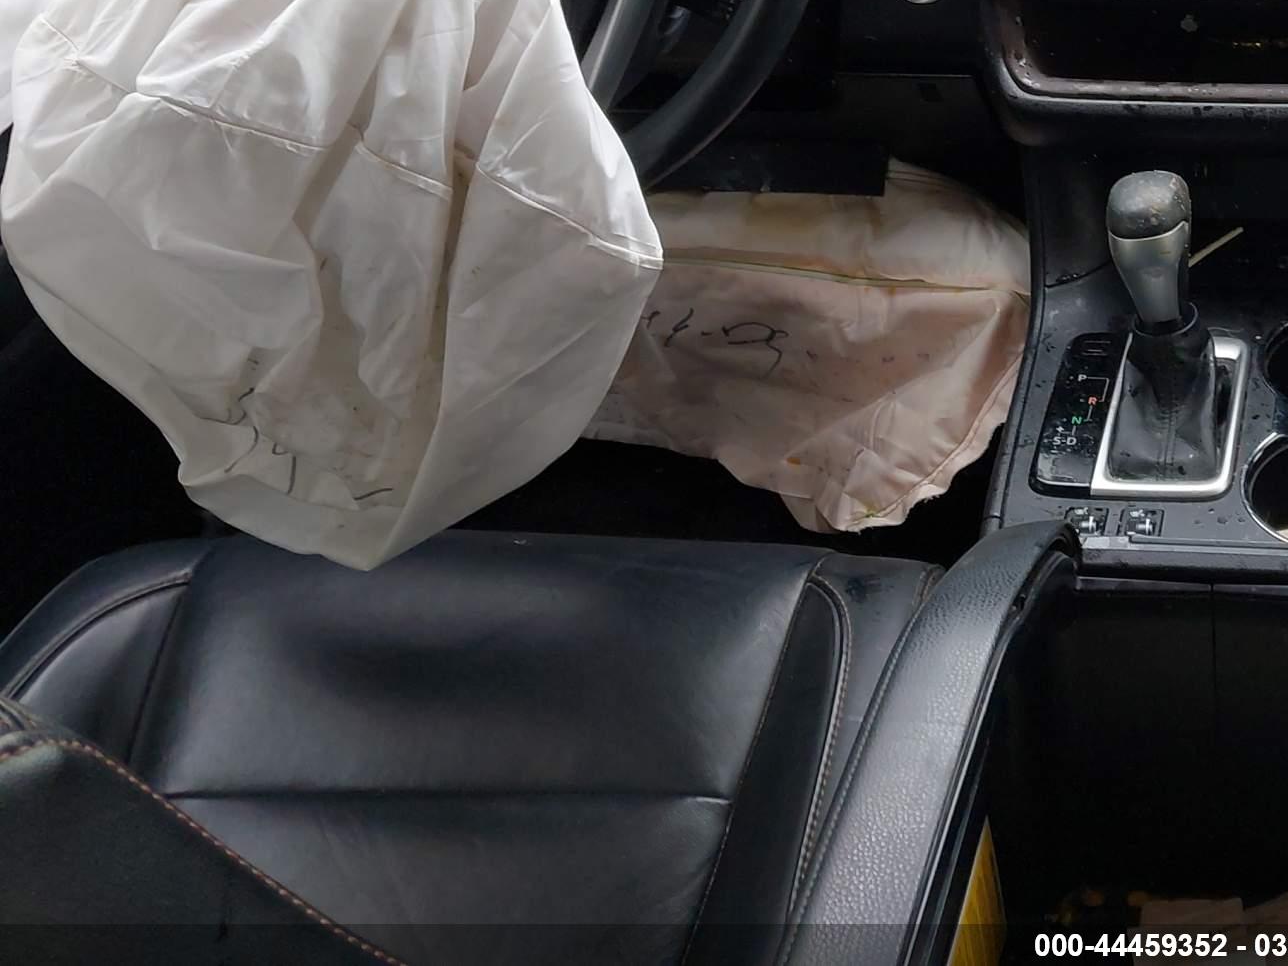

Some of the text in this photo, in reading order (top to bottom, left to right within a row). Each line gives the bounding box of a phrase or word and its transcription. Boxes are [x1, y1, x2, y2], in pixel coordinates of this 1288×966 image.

[1077, 374, 1087, 382] P
[1088, 396, 1098, 405] R
[1071, 416, 1082, 425] N
